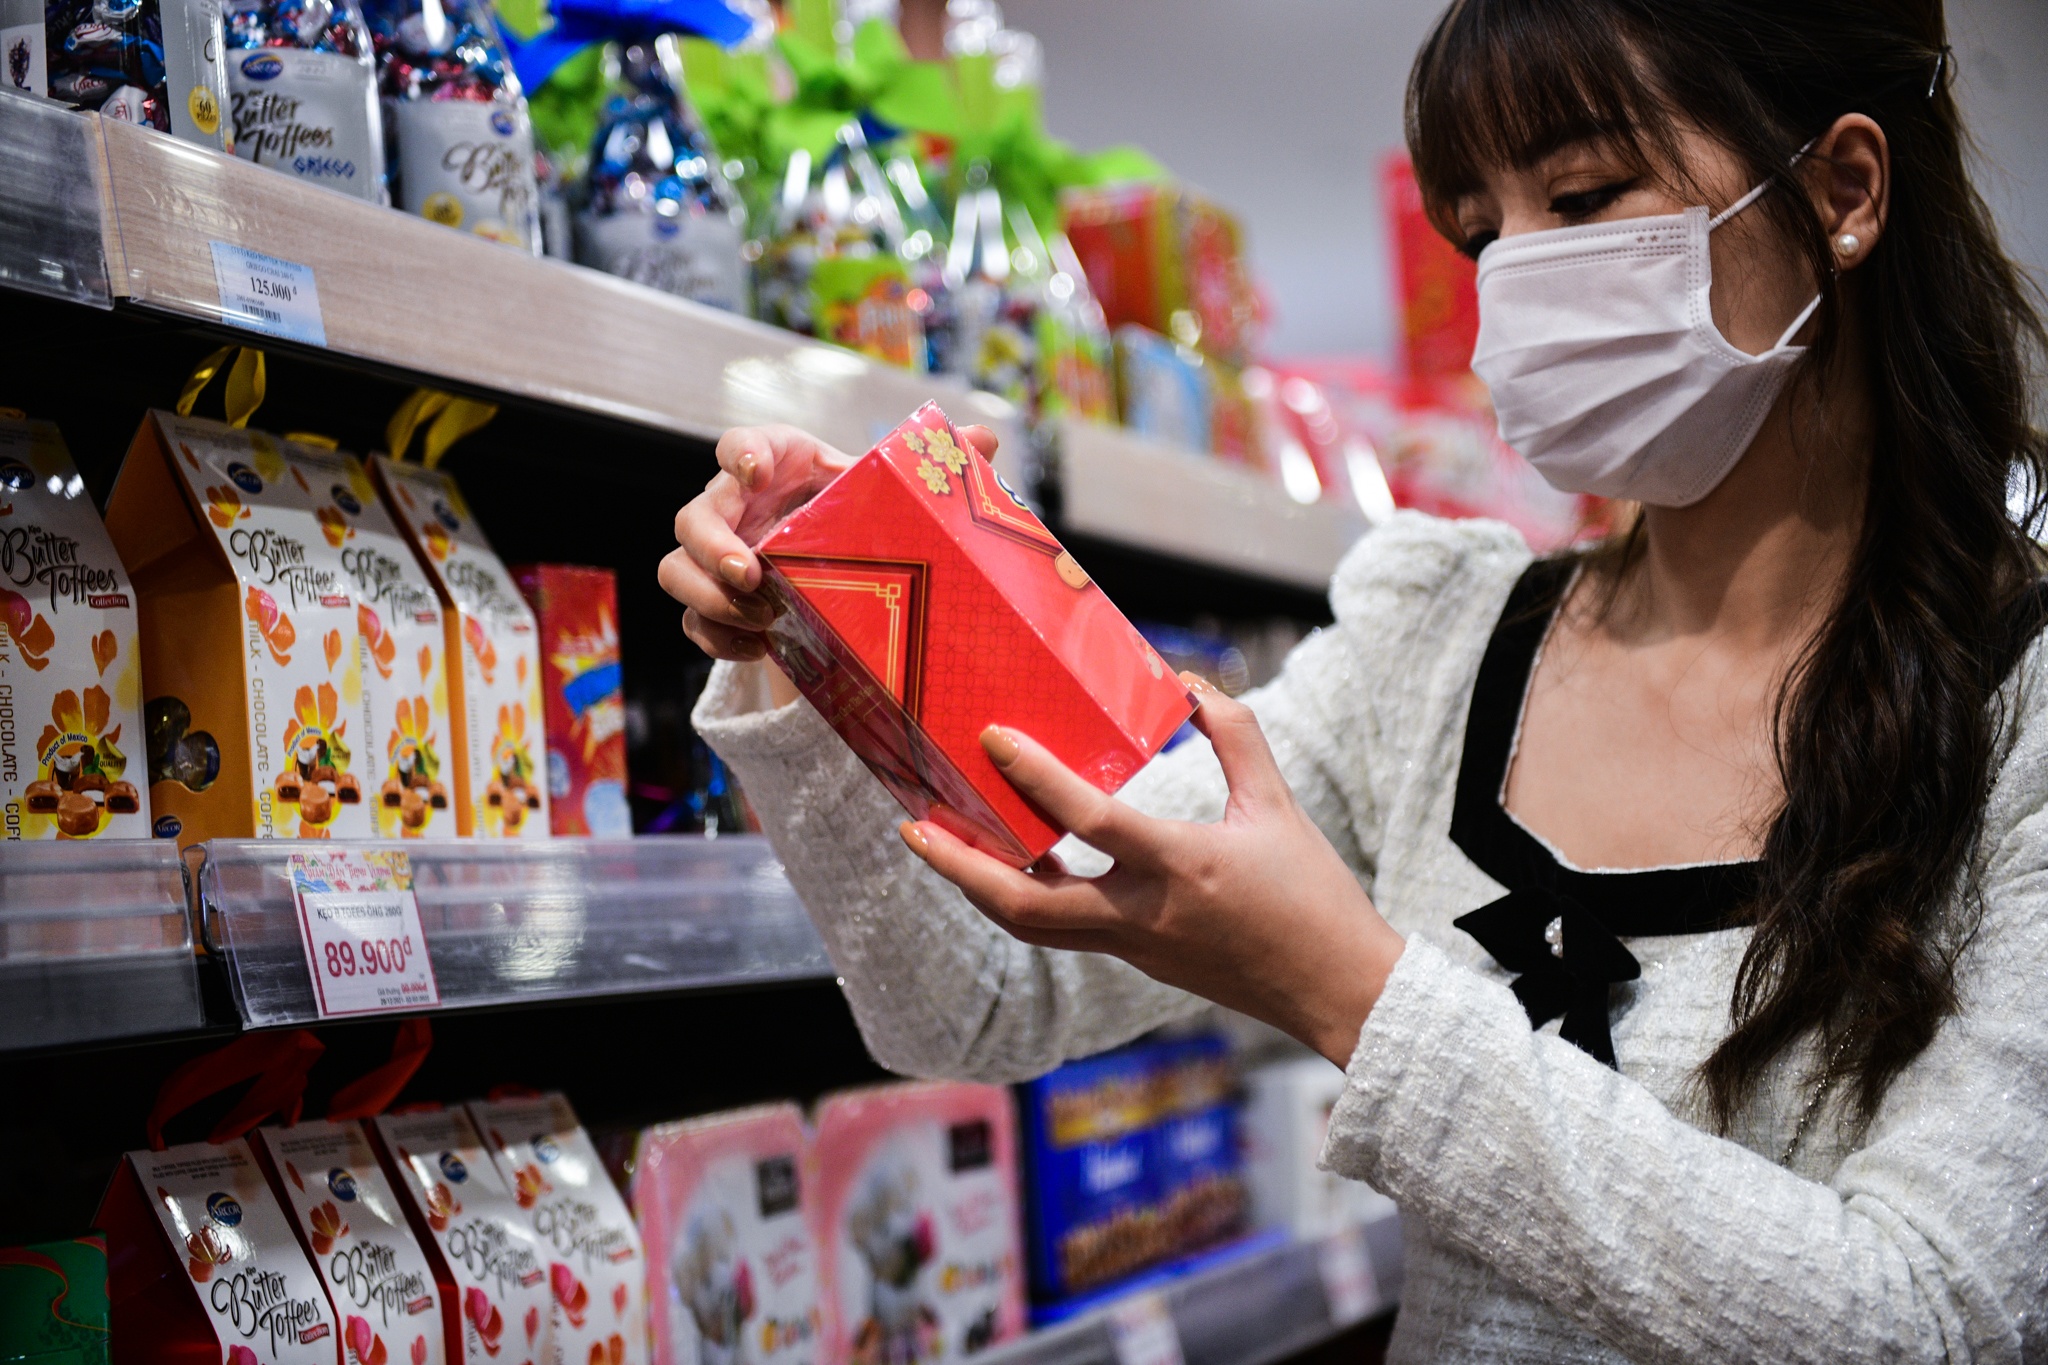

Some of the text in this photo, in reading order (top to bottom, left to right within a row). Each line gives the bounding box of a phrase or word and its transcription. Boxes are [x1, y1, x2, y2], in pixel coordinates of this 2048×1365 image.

[231, 91, 303, 144] Butter
[241, 123, 334, 163] Toffees
[250, 276, 292, 302] 125.000
[0, 527, 80, 588] Butter
[230, 528, 306, 585] Butter
[36, 564, 118, 615] Toffees
[90, 597, 127, 607] Collection
[279, 566, 336, 612] Toffees
[0, 684, 18, 782] CHOCOLATE
[41, 732, 89, 767] Product of Mexico
[252, 678, 270, 772] CHOCOLATE
[209, 1202, 242, 1217] ARCOR
[331, 1245, 397, 1308] Butter
[372, 1273, 425, 1329] Toffees
[210, 1271, 288, 1338] Butter
[258, 1298, 320, 1360] Toffees
